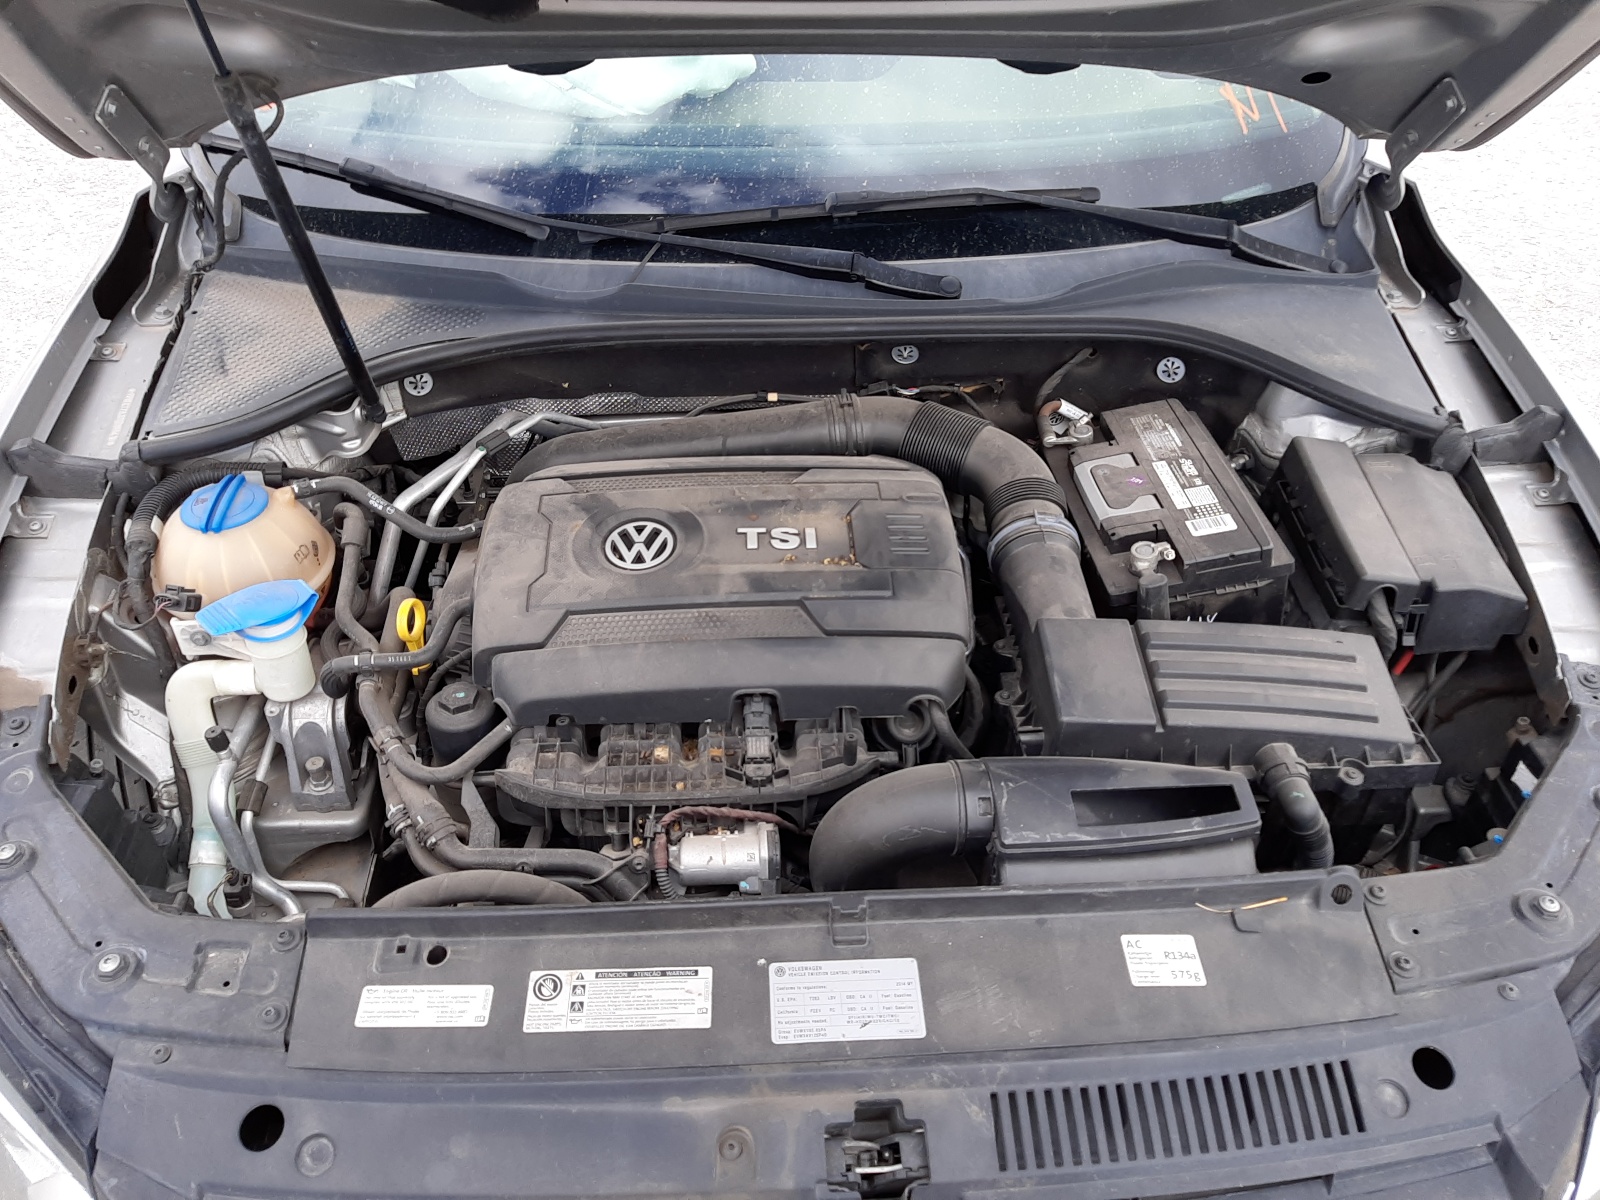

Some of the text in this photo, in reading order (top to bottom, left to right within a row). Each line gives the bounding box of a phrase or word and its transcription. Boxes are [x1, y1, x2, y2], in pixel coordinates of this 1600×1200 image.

[736, 526, 818, 550] TSI
[1126, 940, 1142, 949] AC
[1163, 951, 1197, 960] R134a
